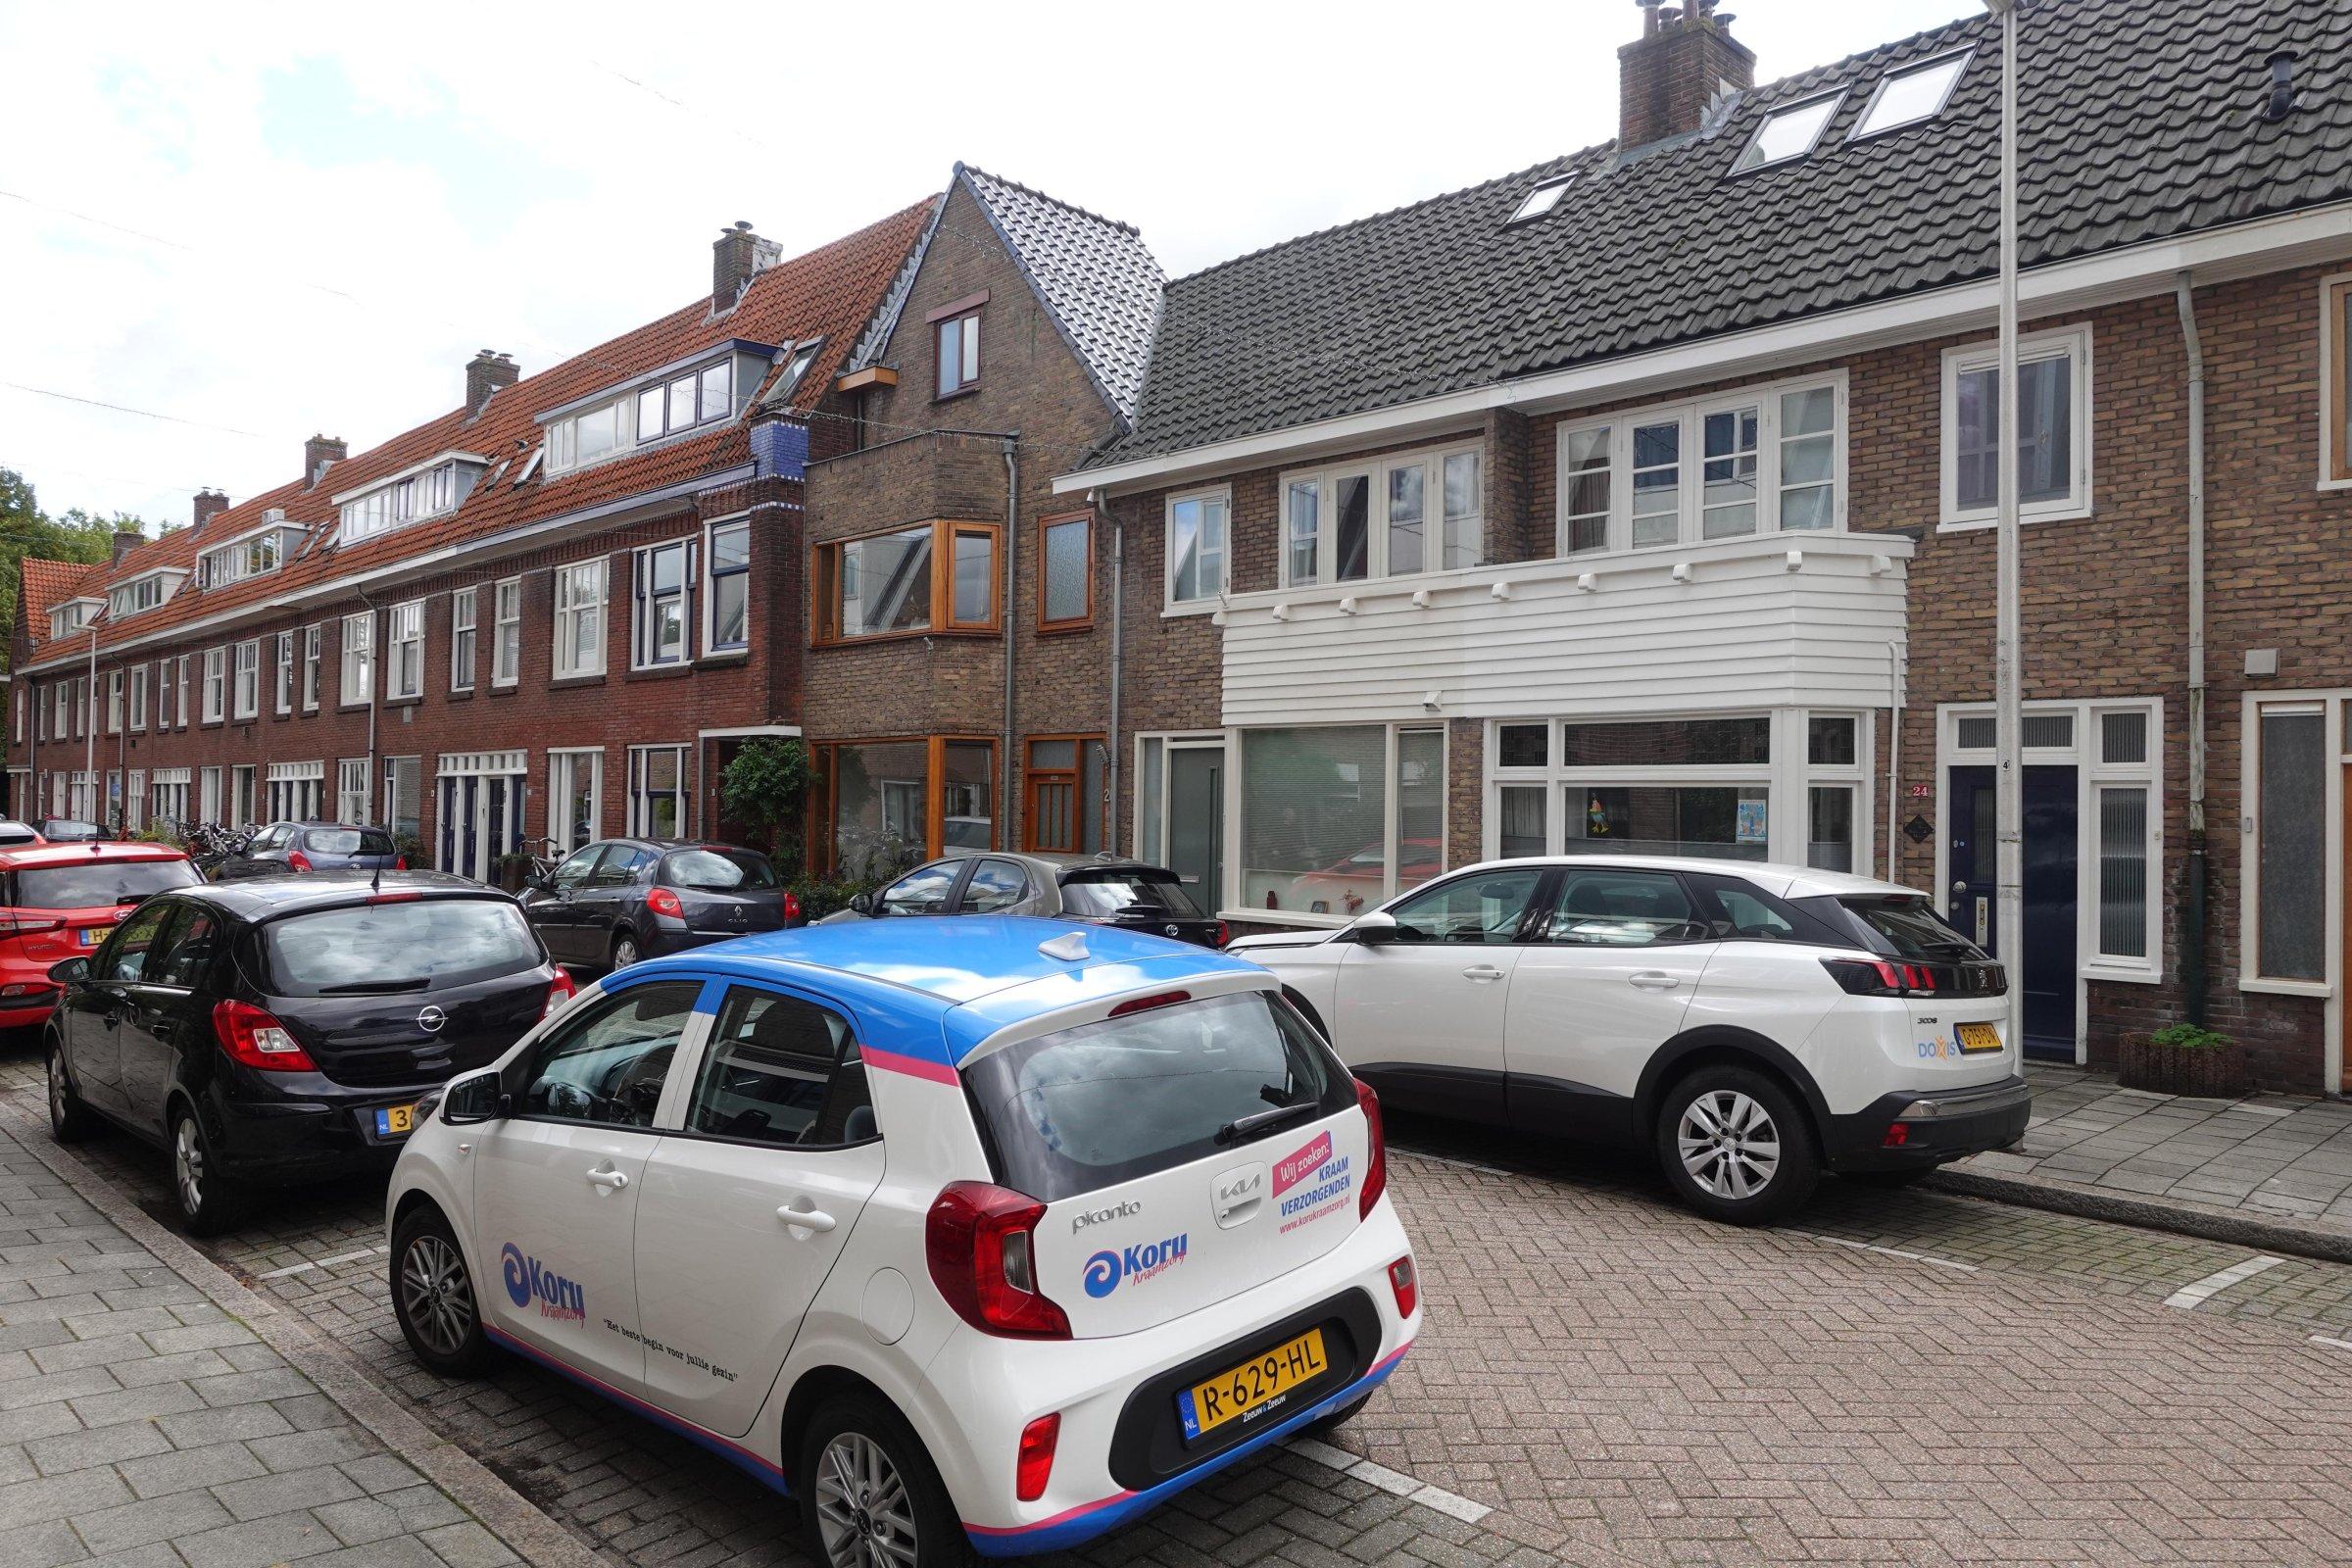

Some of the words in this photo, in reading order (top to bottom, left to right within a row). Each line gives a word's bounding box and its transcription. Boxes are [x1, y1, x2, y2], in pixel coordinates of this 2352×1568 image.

[1103, 788, 1109, 803] 2
[1913, 786, 1929, 797] 24
[1918, 1036, 1956, 1060] DOXIS
[1280, 1161, 1297, 1182] Wij
[1298, 1143, 1330, 1172] zoeken:
[1318, 1155, 1348, 1182] KRAAM
[1281, 1174, 1350, 1216] VERZORGENDEN
[1072, 1200, 1141, 1235] picanto
[1279, 1194, 1350, 1235] www.korukraamzorg.nl
[1124, 1233, 1188, 1276] Koru
[527, 1255, 586, 1319] Koru
[620, 1326, 641, 1342] beste
[642, 1334, 664, 1352] begin
[666, 1346, 684, 1360] voor
[686, 1352, 710, 1371] jullie
[1202, 1339, 1321, 1422] R-629-HL
[1184, 1418, 1198, 1432] NL
[1243, 1405, 1263, 1423] Zeeuw
[1267, 1394, 1287, 1411] Zeeuw
